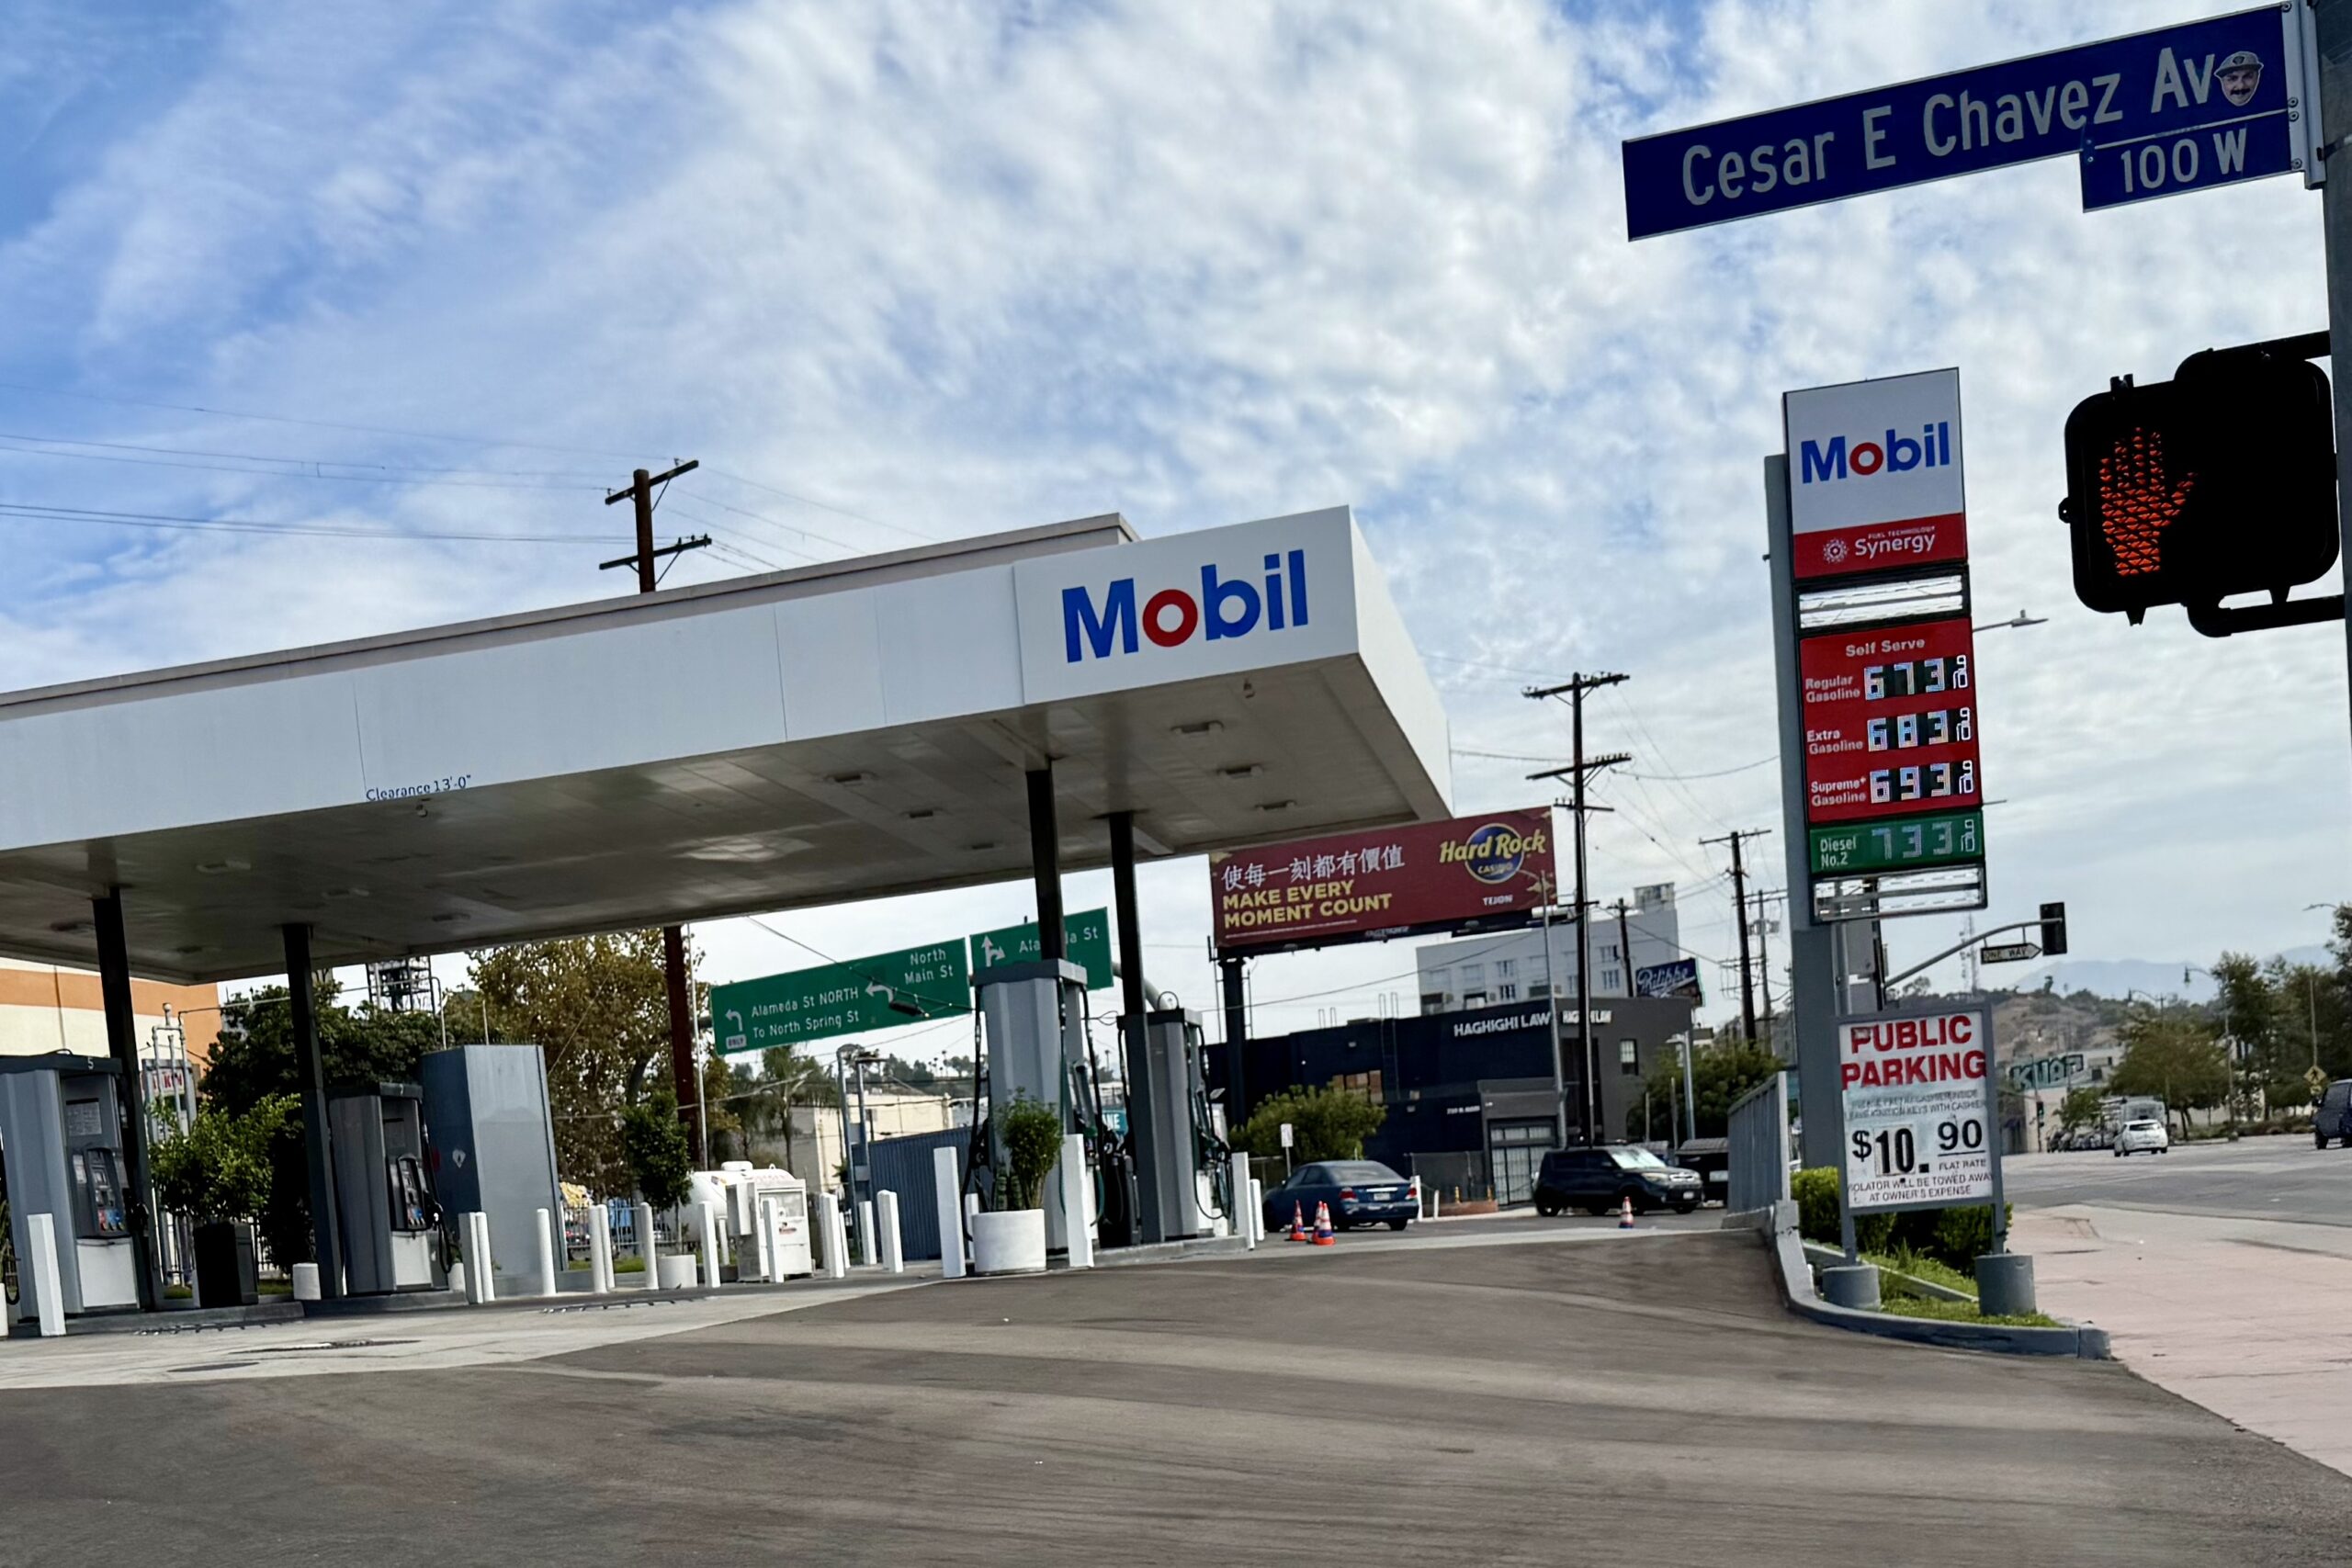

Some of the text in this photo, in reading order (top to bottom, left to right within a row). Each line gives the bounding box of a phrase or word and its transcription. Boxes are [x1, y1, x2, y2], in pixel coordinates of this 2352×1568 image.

[1682, 131, 1835, 207] Cesar
[1863, 106, 1896, 170] E
[1923, 72, 2124, 157] Chavez
[2120, 128, 2247, 193] 100 W
[1801, 422, 1950, 483] Mobil
[1855, 534, 1935, 559] Synergy
[1062, 549, 1308, 663] Mobil
[1846, 638, 1925, 657] Self Serve
[1805, 675, 1853, 690] Regular
[1805, 688, 1860, 703] Gasoline
[1807, 729, 1840, 743] Extra
[1809, 740, 1863, 755] Gasoline
[366, 784, 431, 801] Clearance
[1811, 792, 1867, 807] Gasoline
[1440, 829, 1546, 863] Hard Rock
[1820, 836, 1857, 852] Diesel
[1221, 843, 1406, 892] 使每一刻都有價值
[1820, 852, 1849, 870] No.2
[1223, 879, 1354, 910] MAKE EVERY
[1224, 893, 1393, 929] MOMENT COUNT
[1083, 926, 1099, 941] St
[910, 948, 946, 965] North
[2009, 946, 2029, 957] WAY
[904, 964, 954, 985] Main St
[752, 987, 859, 1018] Alameda St NORTH
[753, 1010, 859, 1038] To North Spring St
[1453, 1011, 1551, 1037] HAGHIGHI LAW
[1850, 1015, 1973, 1054] PUBLIC
[87, 1057, 94, 1070] 5
[1841, 1050, 1987, 1090] PARKING
[1939, 1158, 1986, 1171] FLAT RATE
[1917, 1177, 1929, 1187] BE
[1932, 1173, 1966, 1186] TOWED
[1869, 1192, 1882, 1202] AT
[1928, 1185, 1972, 1198] EXPENSE
